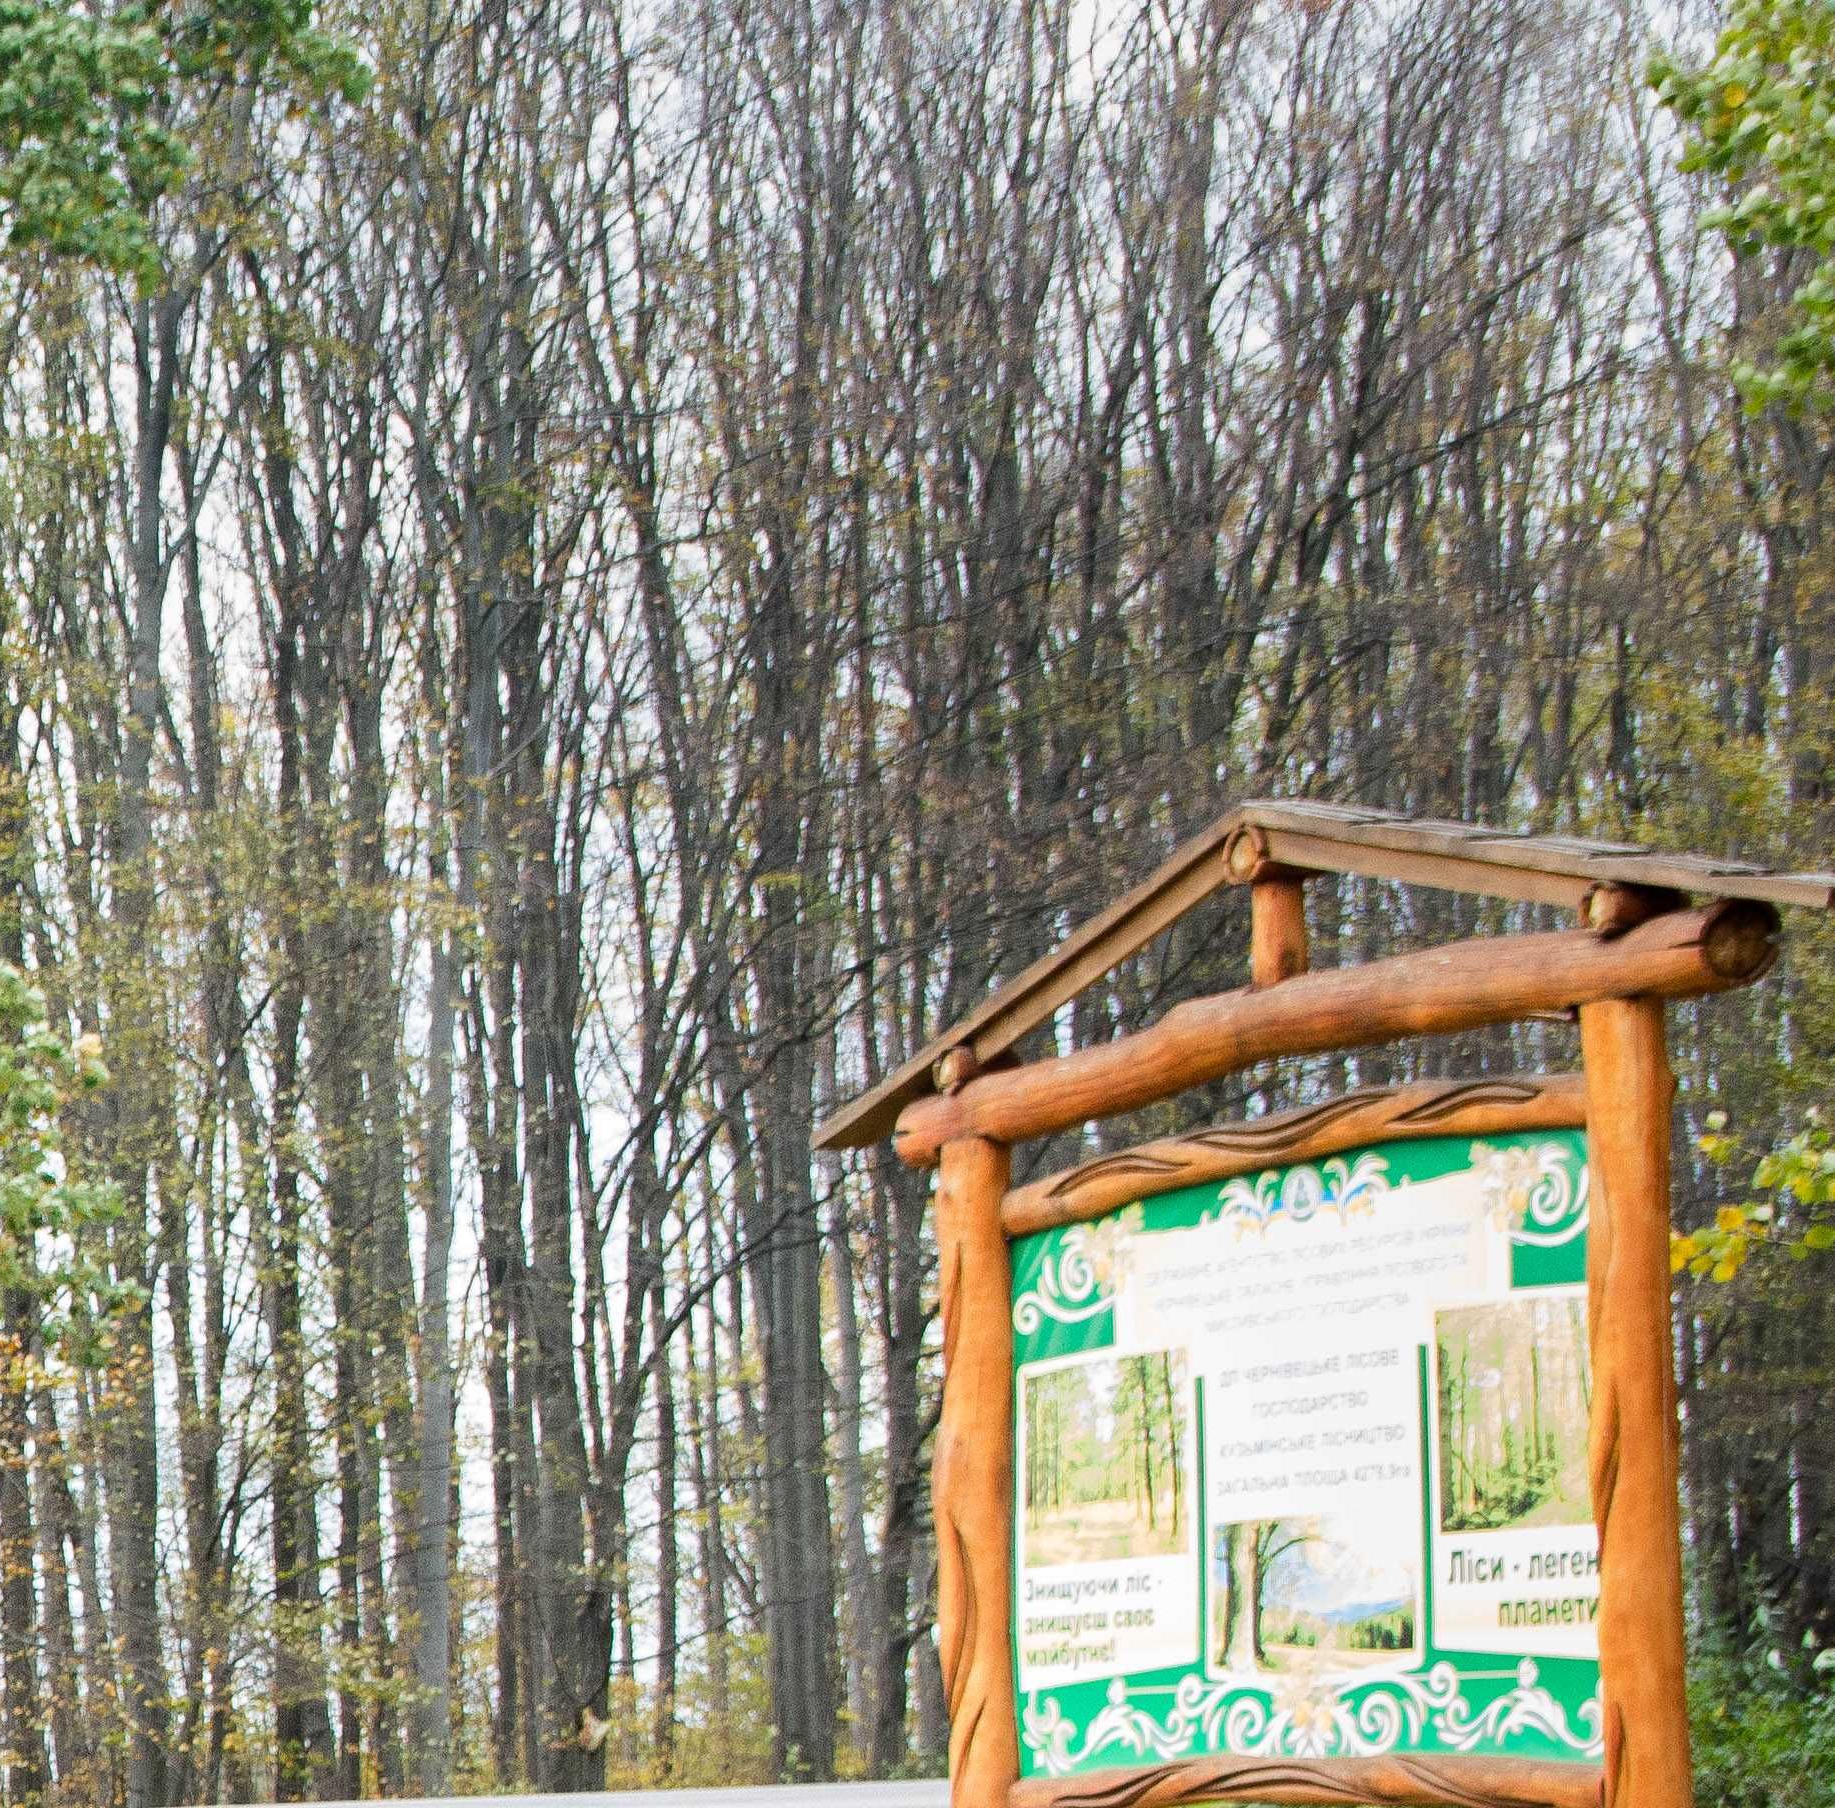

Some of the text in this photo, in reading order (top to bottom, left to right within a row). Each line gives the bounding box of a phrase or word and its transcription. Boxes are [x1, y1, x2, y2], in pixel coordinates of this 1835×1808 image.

[1449, 1549, 1505, 1584] Ліси
[1529, 1550, 1599, 1580] леген
[1024, 1575, 1119, 1604] Знищуючи
[1125, 1572, 1152, 1595] ліс
